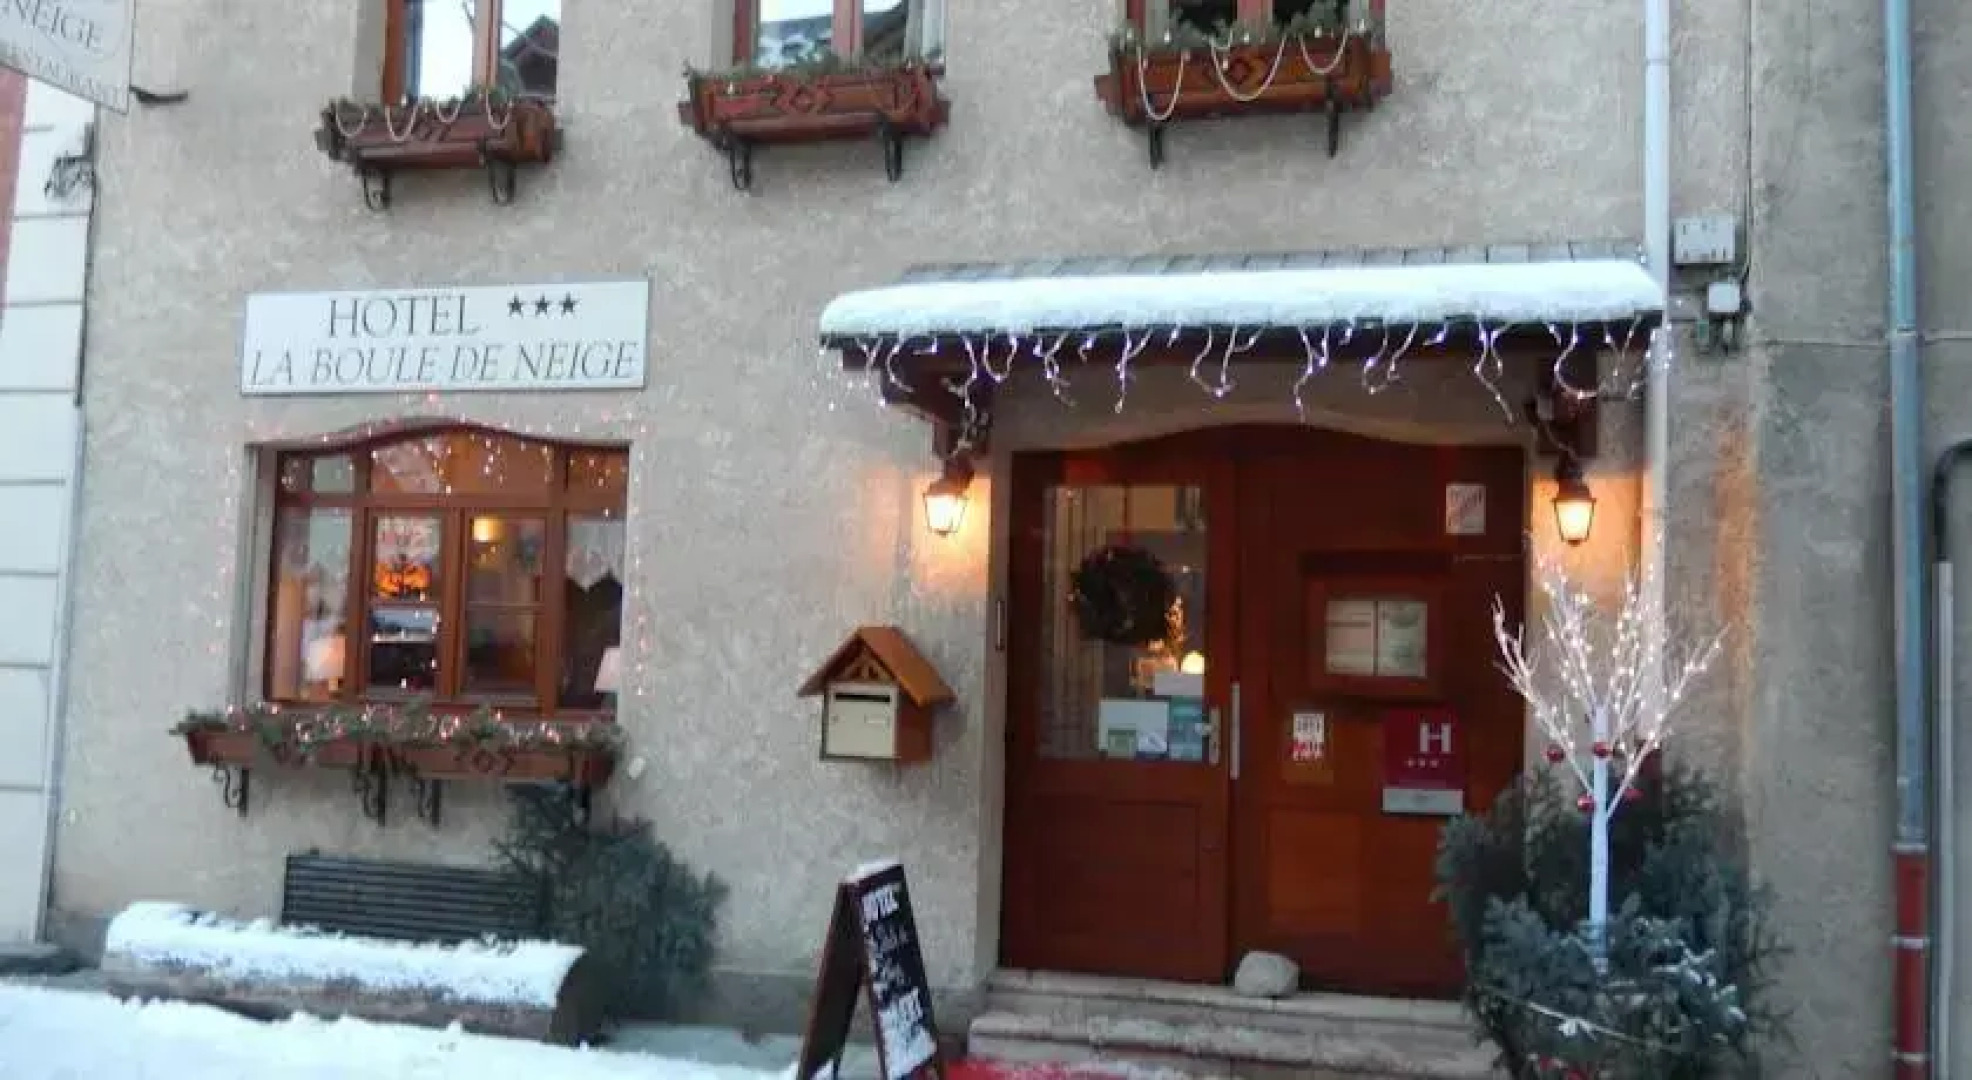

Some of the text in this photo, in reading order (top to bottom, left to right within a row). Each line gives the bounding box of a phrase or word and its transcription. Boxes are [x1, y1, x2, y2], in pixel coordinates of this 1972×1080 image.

[2, 0, 103, 55] NEIGE
[328, 294, 482, 338] HOTEL
[251, 338, 639, 386] LA BOULE DE NEIGE
[1418, 722, 1452, 753] H
